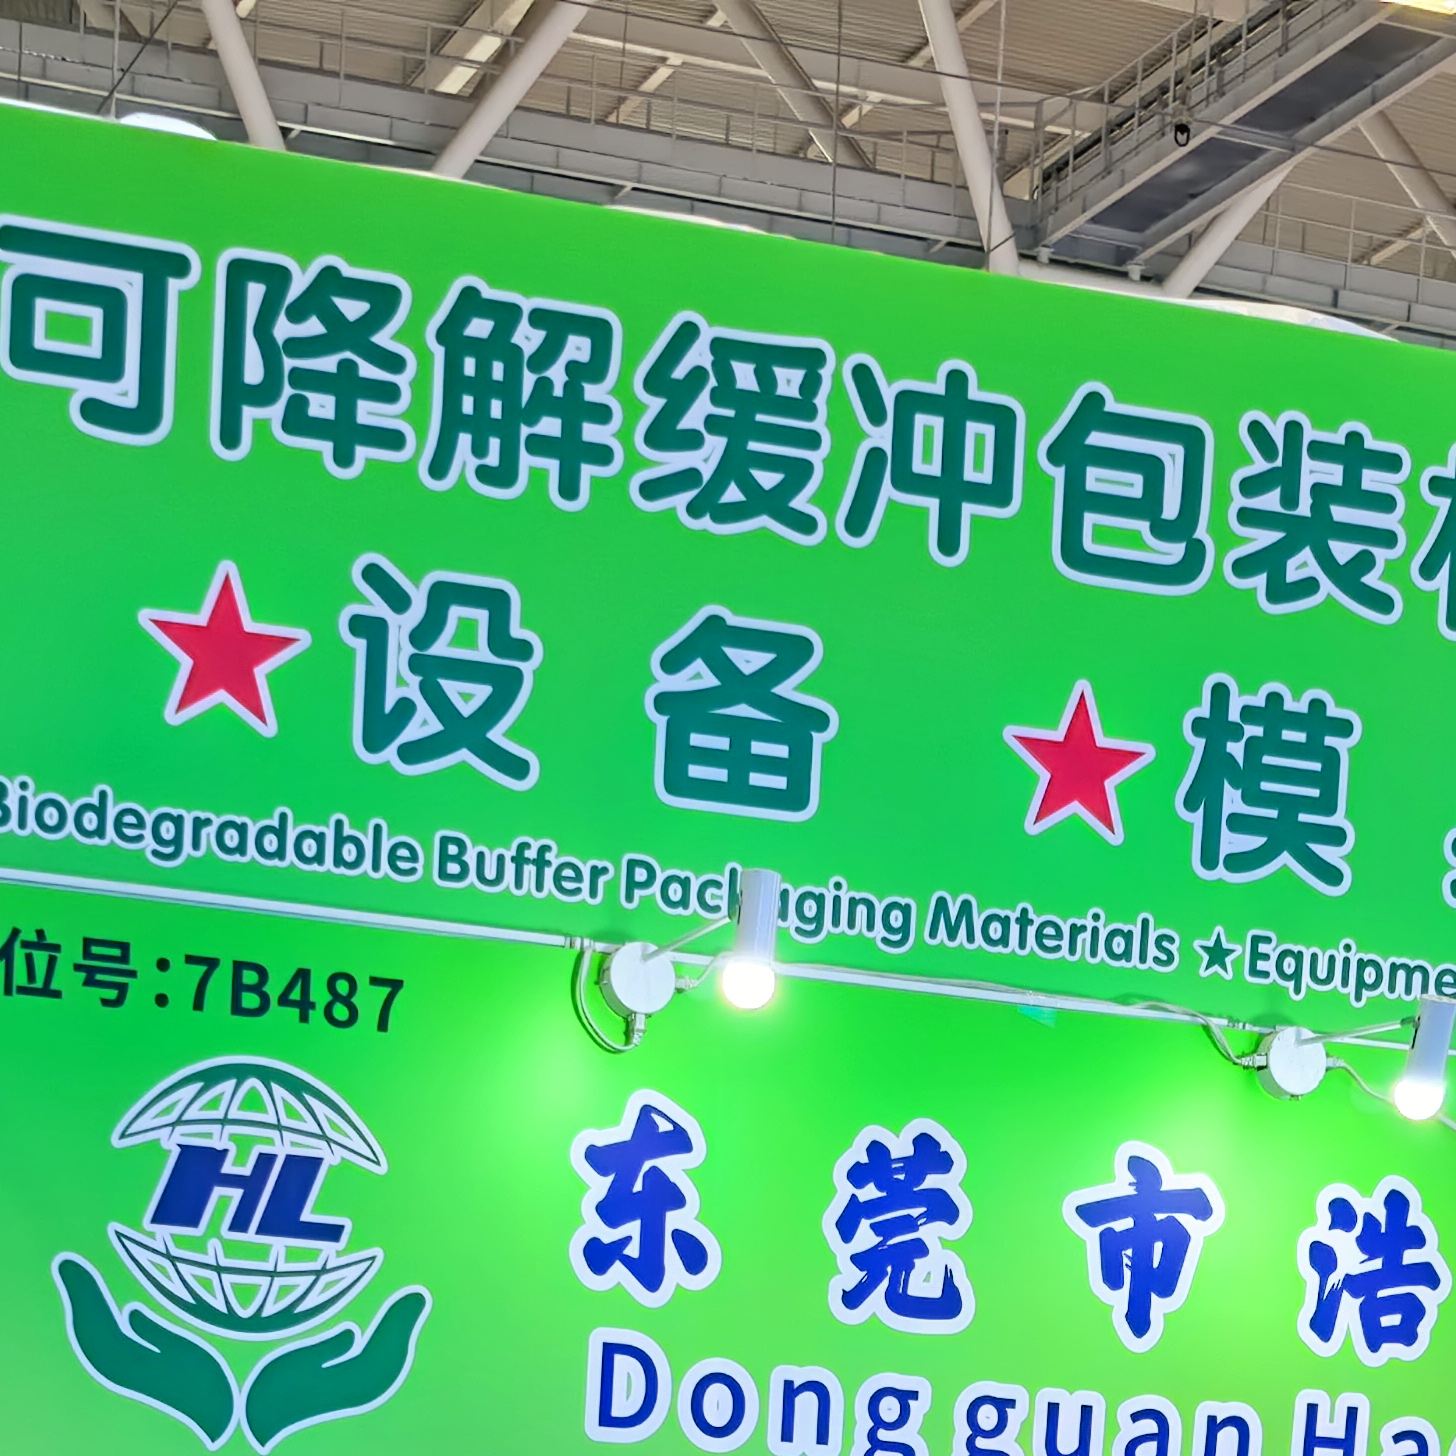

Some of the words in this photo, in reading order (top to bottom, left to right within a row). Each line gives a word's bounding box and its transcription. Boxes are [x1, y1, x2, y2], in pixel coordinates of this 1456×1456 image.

[341, 554, 836, 819] 设备
[434, 830, 612, 905] Buffer
[924, 889, 1180, 973] Materials
[148, 1141, 348, 1244] HL
